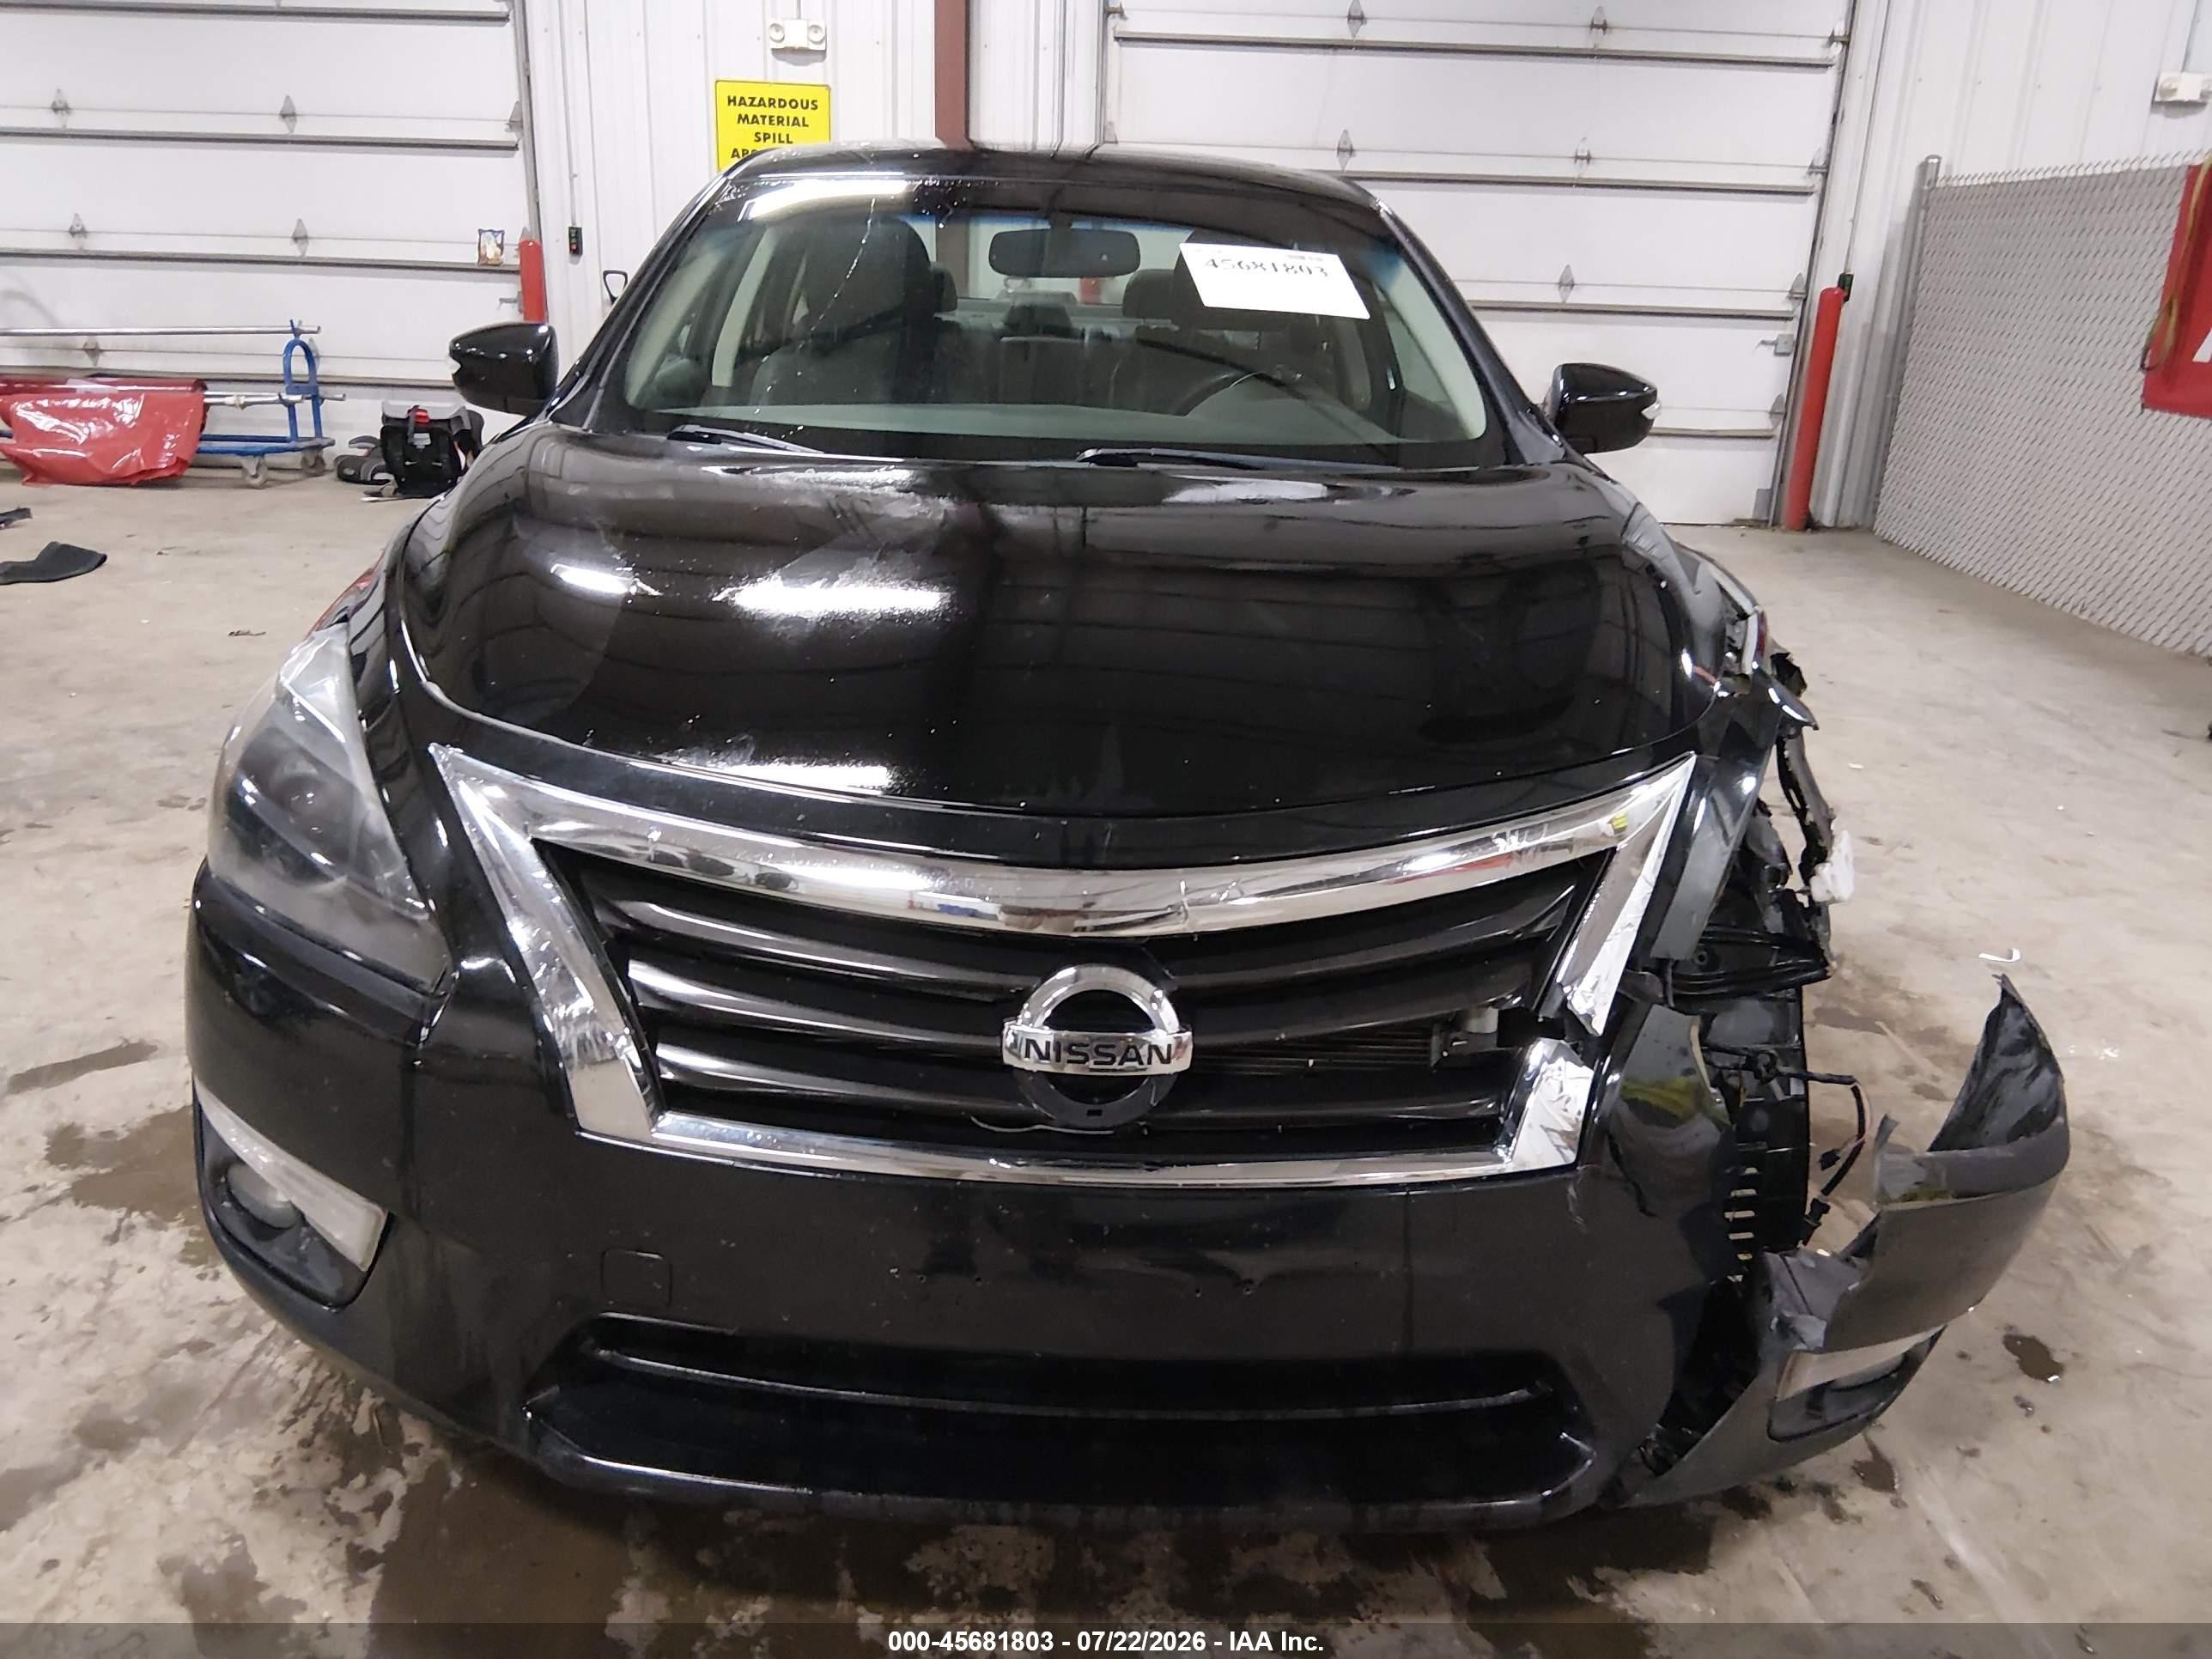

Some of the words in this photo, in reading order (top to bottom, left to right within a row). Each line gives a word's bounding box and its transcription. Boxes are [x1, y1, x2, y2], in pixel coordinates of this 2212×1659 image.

[727, 95, 818, 110] HAZARDOUS
[737, 113, 810, 128] MATERIAL
[754, 131, 793, 144] SPILL
[1024, 1038, 1172, 1066] NISSAN
